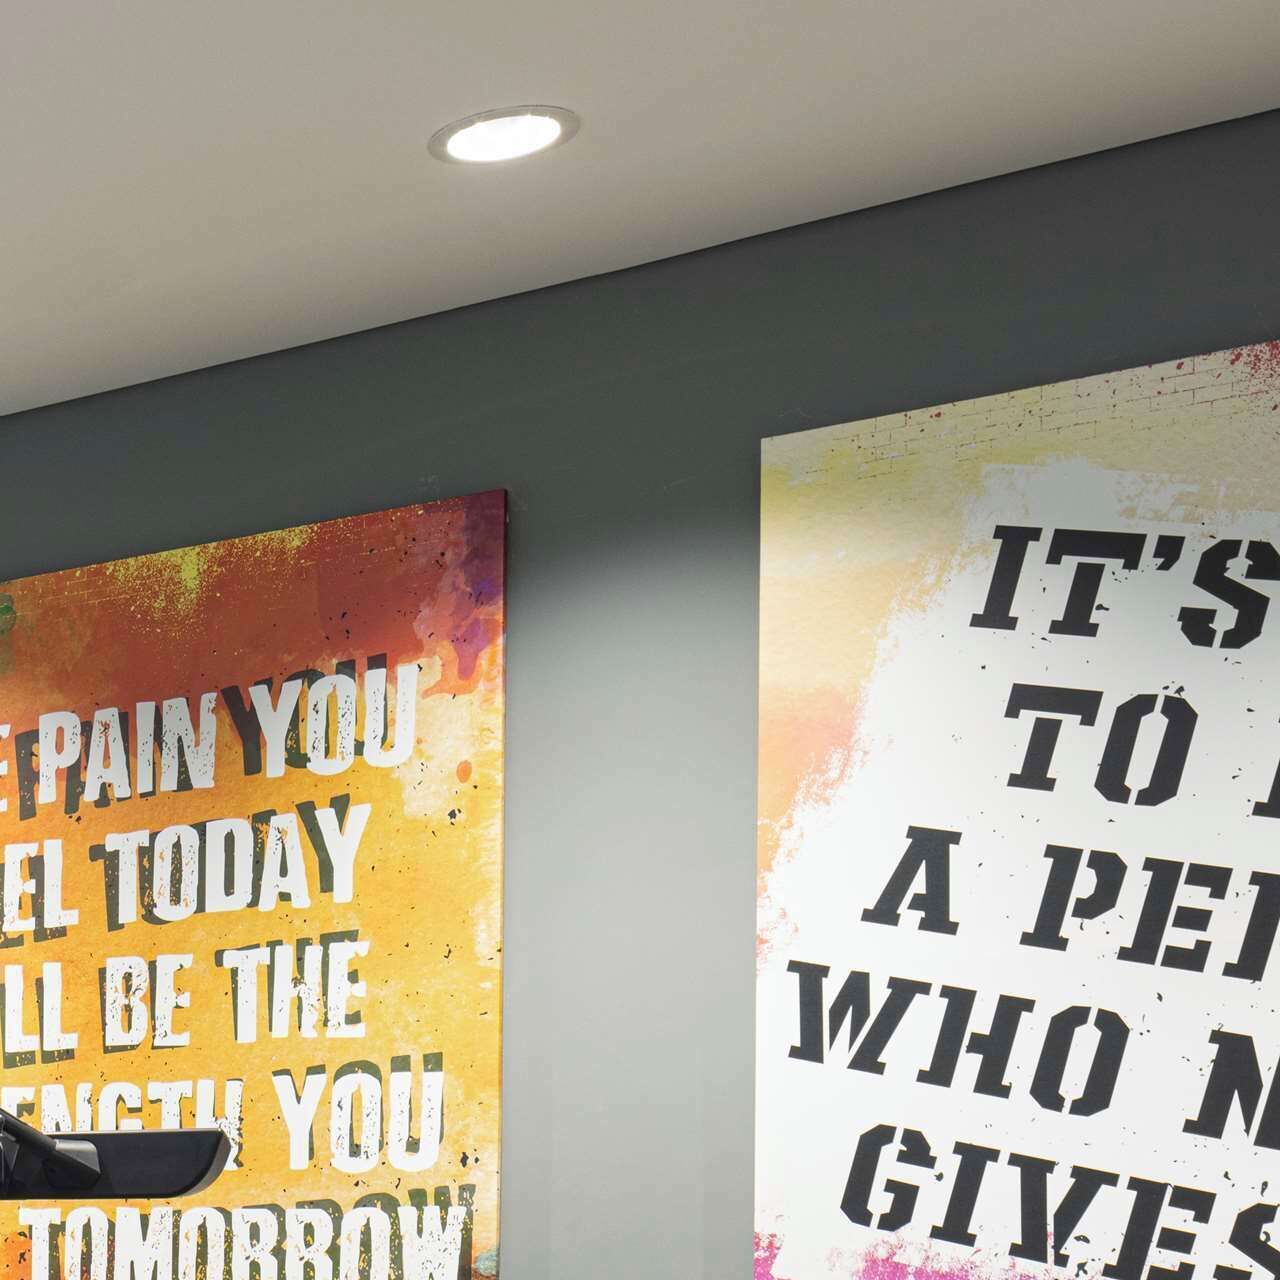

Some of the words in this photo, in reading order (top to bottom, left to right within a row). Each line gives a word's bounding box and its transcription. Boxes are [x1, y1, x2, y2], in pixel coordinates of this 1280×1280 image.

[969, 523, 1280, 650] IT'S
[38, 692, 218, 805] PAIN
[248, 662, 418, 779] YOU
[1003, 682, 1199, 807] TO
[105, 803, 372, 924] TODAY
[860, 824, 961, 936] A
[105, 953, 193, 1048] BE
[223, 939, 370, 1044] THE
[787, 958, 1131, 1118] WHO
[271, 1069, 444, 1173] YOU
